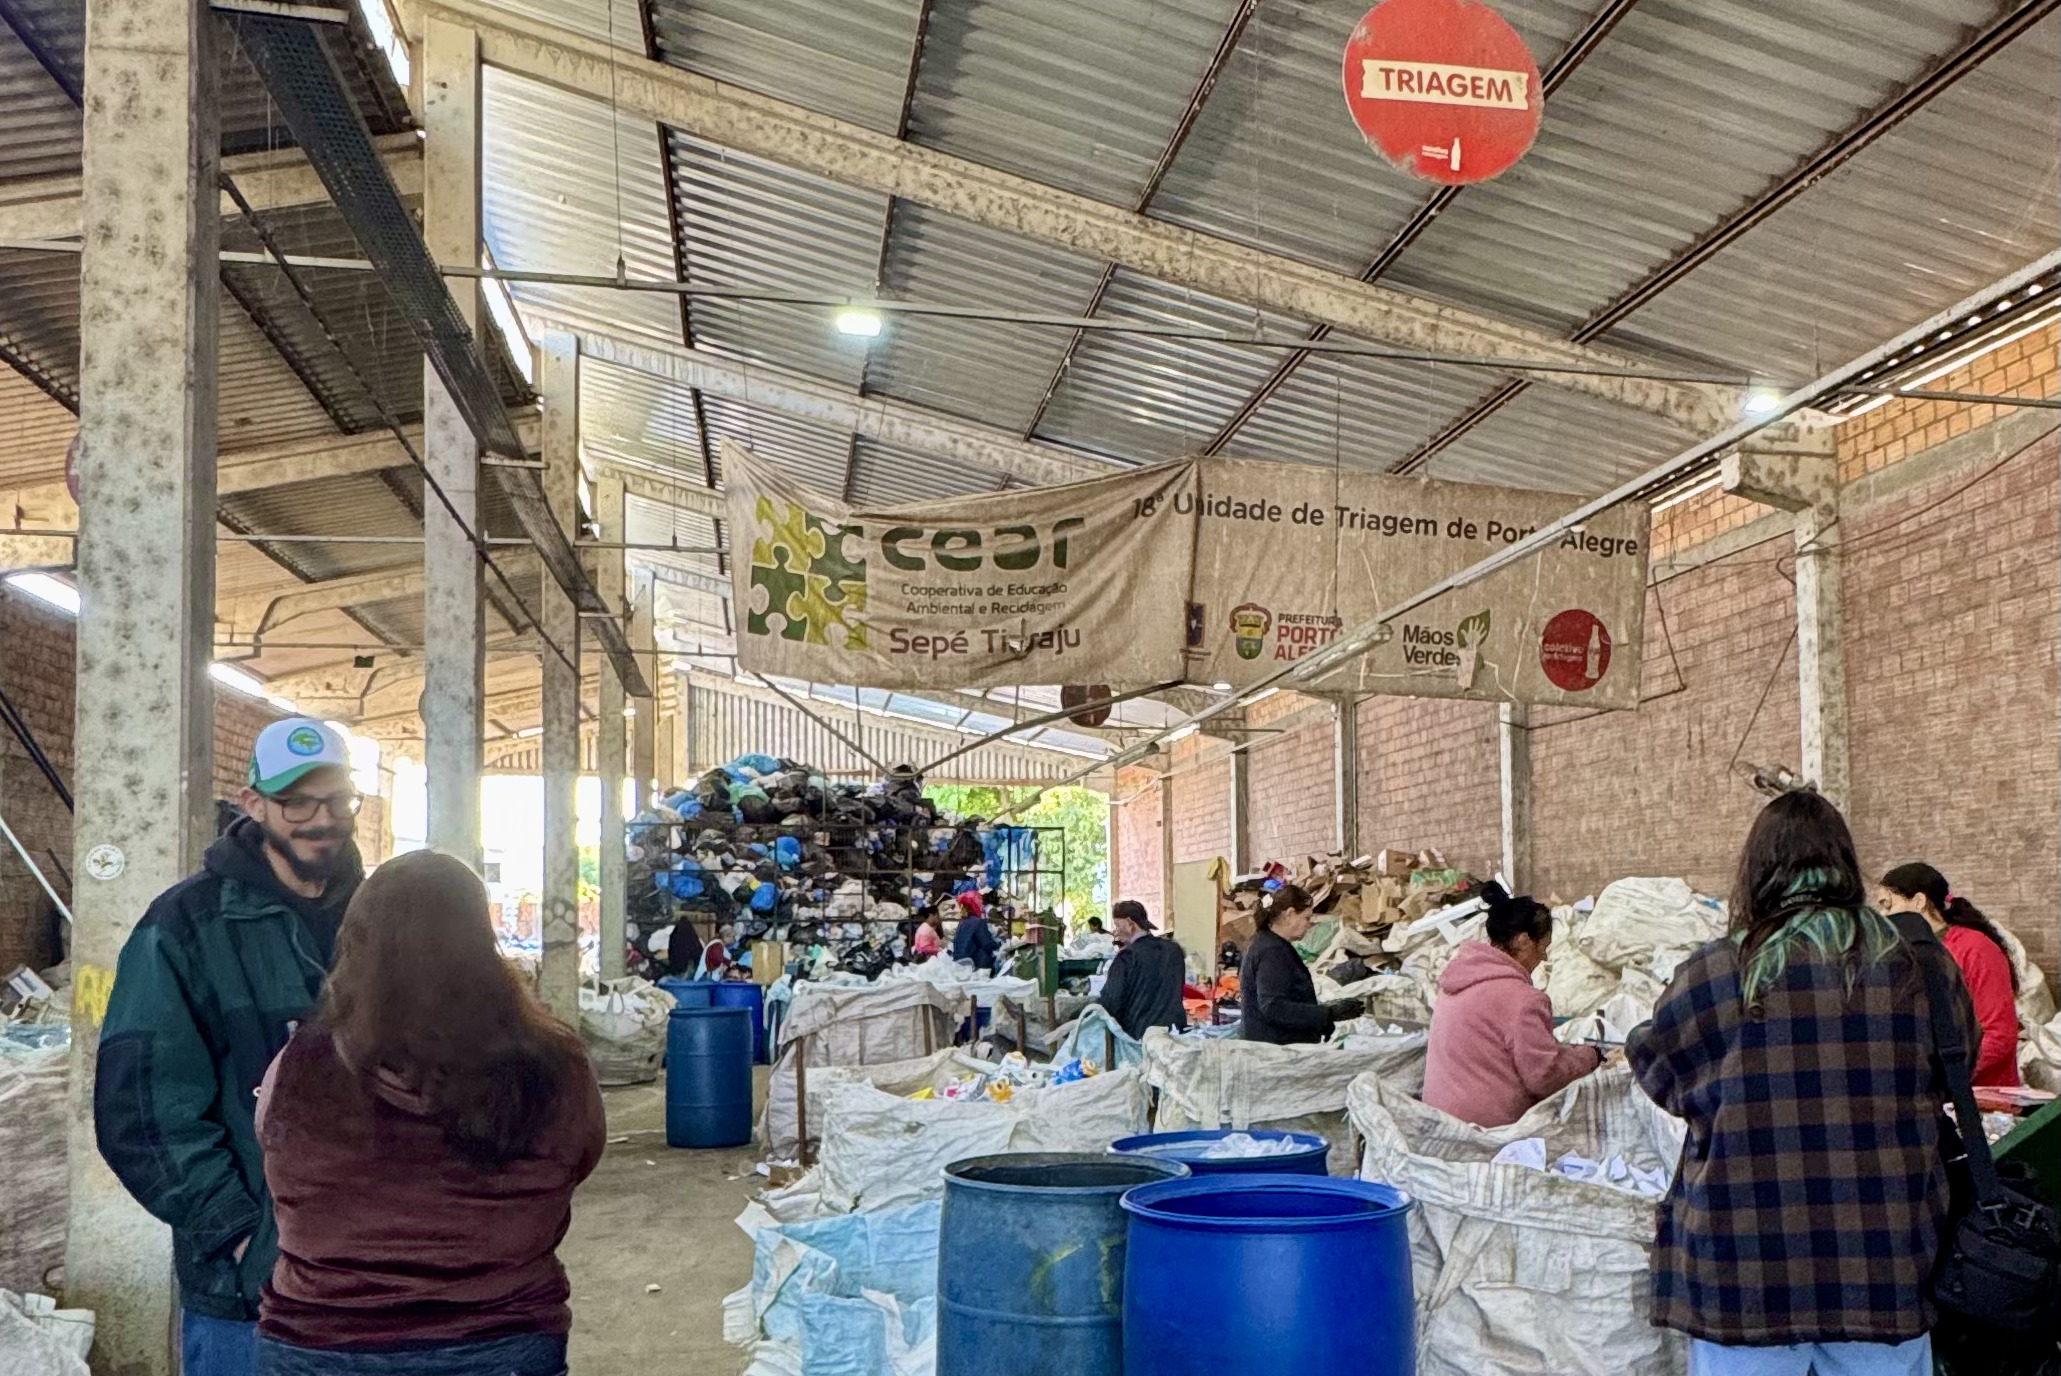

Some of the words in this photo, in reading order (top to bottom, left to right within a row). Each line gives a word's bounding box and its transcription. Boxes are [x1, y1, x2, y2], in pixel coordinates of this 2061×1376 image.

[1379, 67, 1513, 103] TRIAGEM
[1174, 492, 1282, 523] Unidade
[1291, 502, 1325, 526] de
[1335, 506, 1438, 537] Triagem
[1447, 517, 1478, 540] de
[1486, 520, 1538, 544] Port
[1560, 530, 1638, 558] Alegre
[901, 583, 983, 599] Cooperativa
[987, 582, 1004, 597] de
[1007, 582, 1067, 598] Educação
[906, 601, 975, 615] Ambiental
[979, 604, 988, 615] e
[890, 628, 969, 661] Sepé
[981, 623, 1081, 656] Tiraju
[1403, 624, 1455, 646] Mãos
